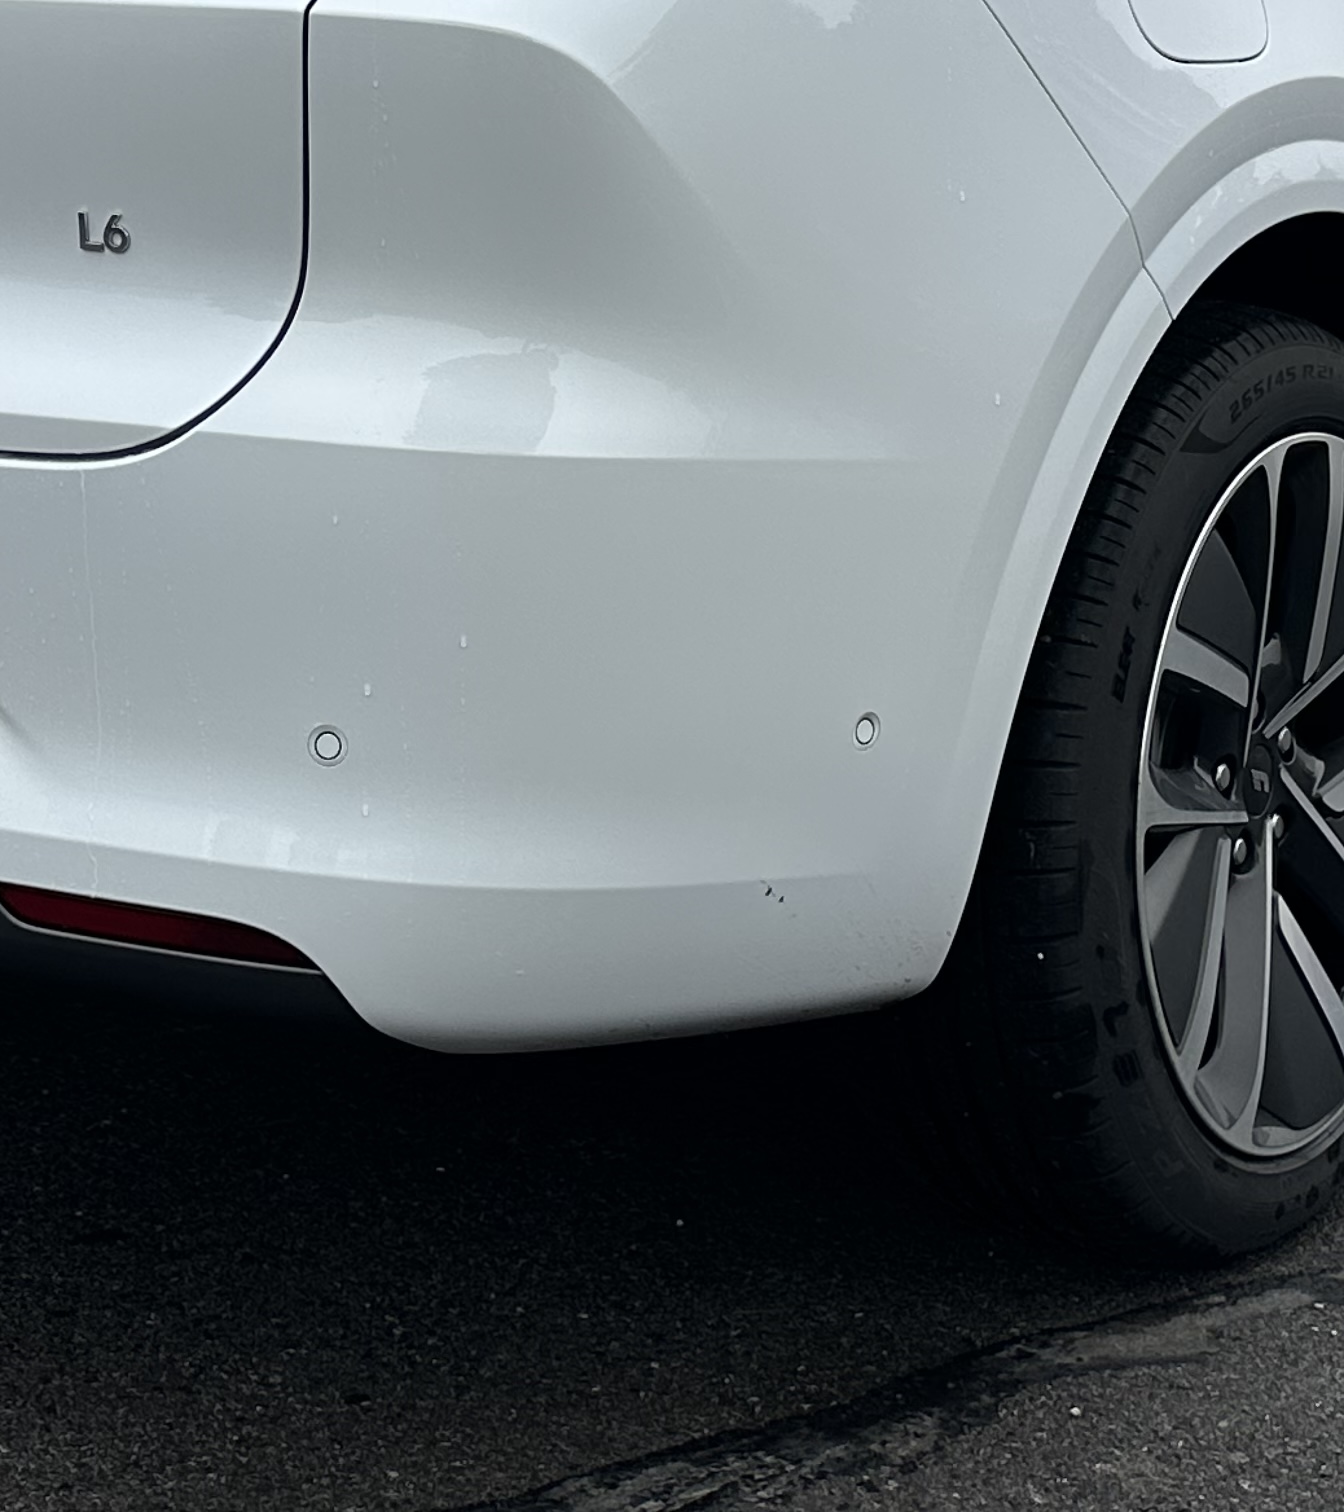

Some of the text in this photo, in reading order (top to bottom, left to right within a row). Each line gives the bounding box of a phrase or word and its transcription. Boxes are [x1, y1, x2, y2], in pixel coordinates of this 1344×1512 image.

[77, 211, 131, 254] L6
[1229, 366, 1297, 425] 265/45
[1303, 364, 1334, 381] R21
